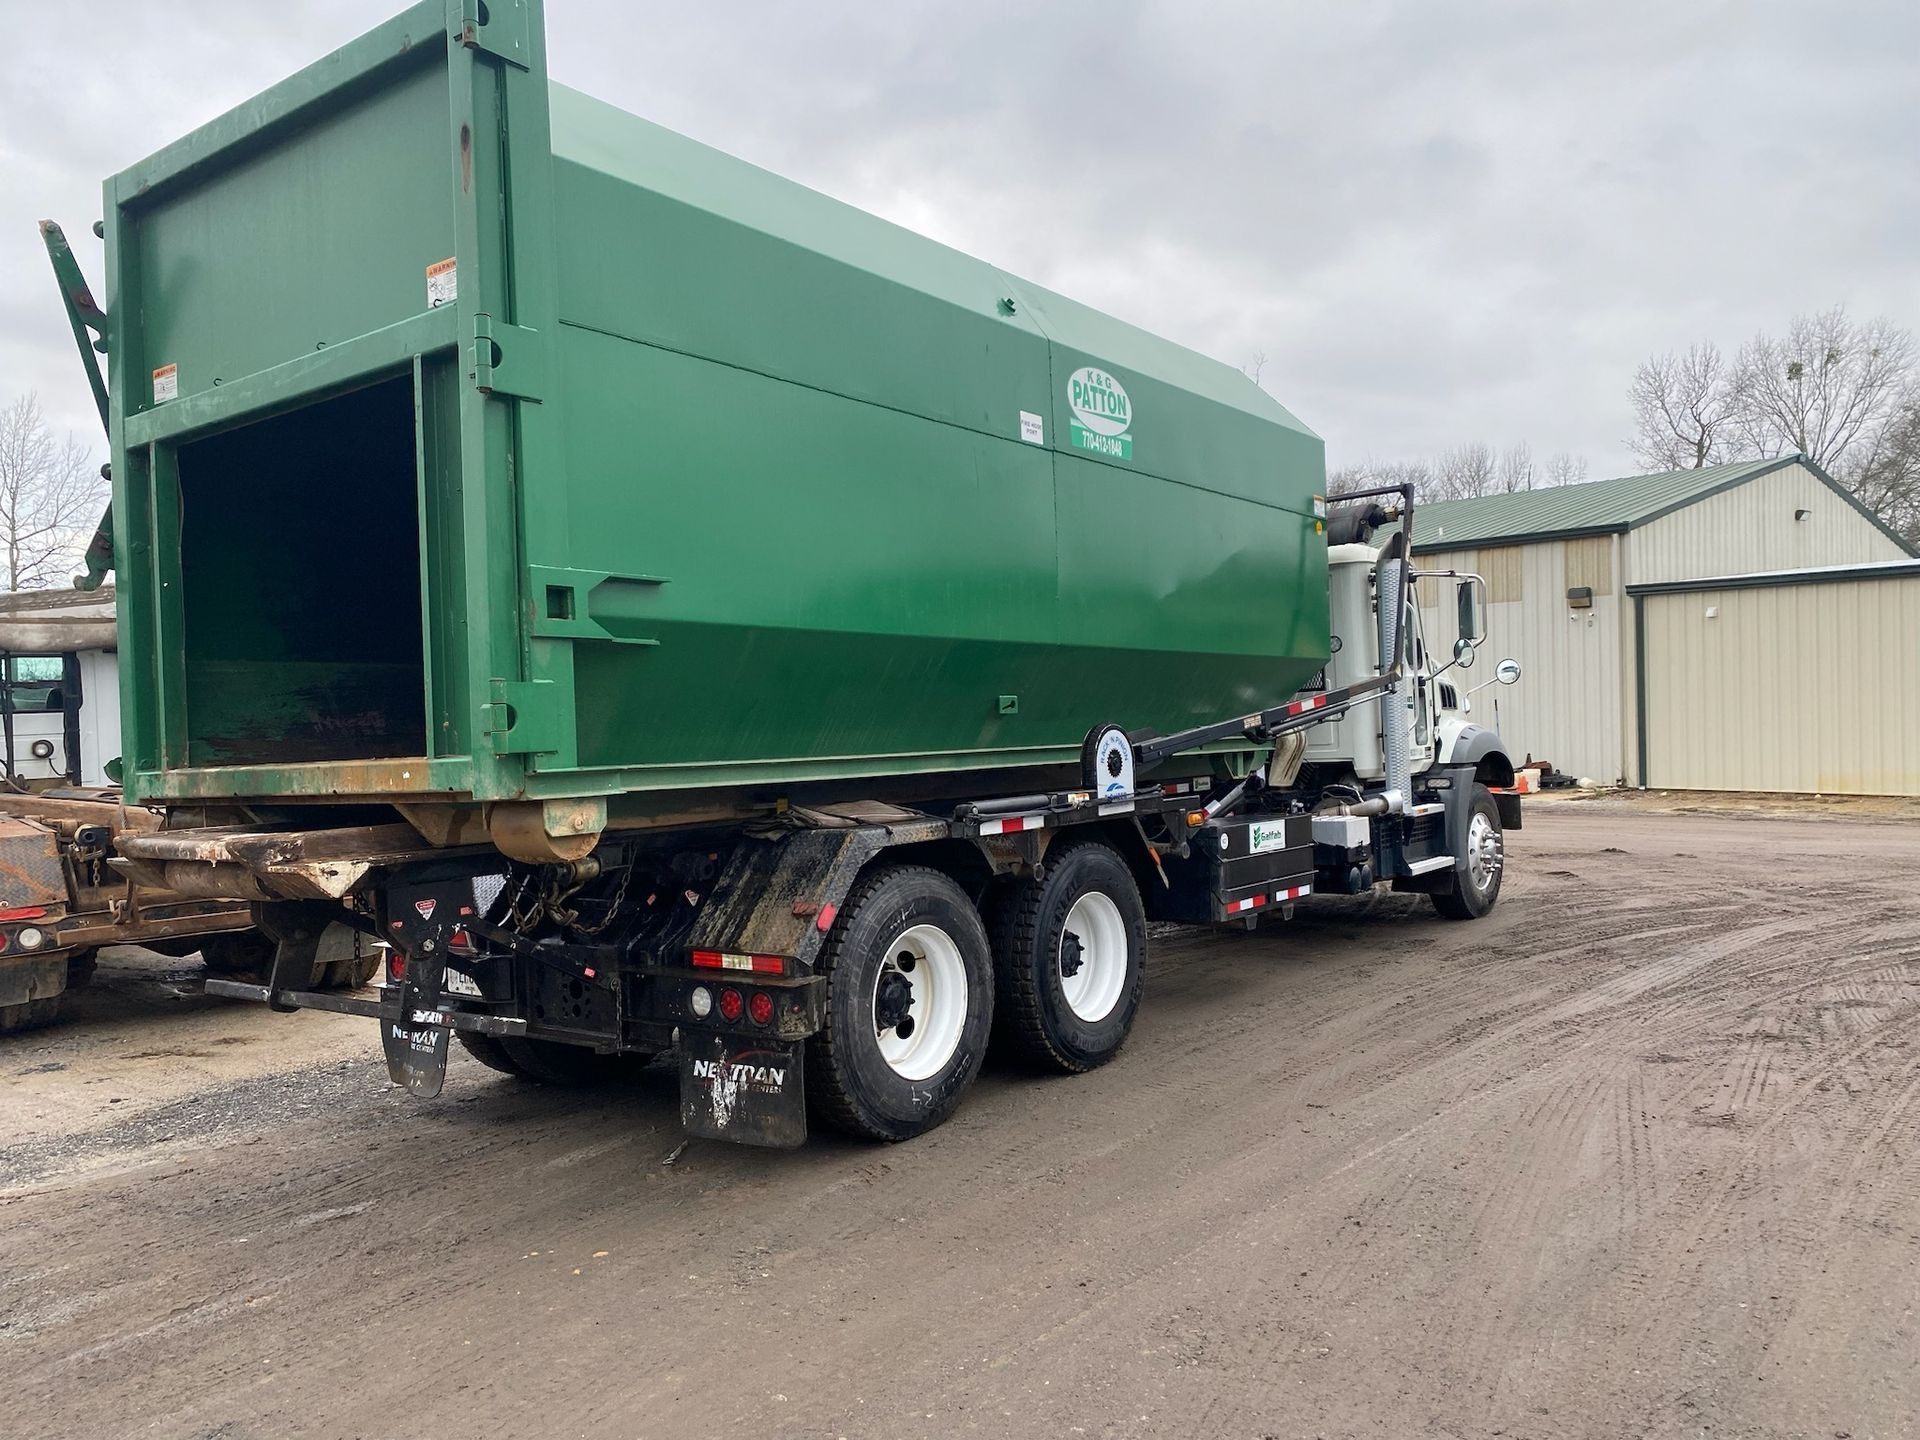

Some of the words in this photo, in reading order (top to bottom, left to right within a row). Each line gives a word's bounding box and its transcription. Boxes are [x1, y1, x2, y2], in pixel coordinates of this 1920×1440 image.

[432, 260, 457, 273] WARNIN
[1087, 370, 1094, 384] K
[1096, 373, 1103, 387] &
[1105, 376, 1112, 389] G
[1072, 379, 1127, 417] PATTON
